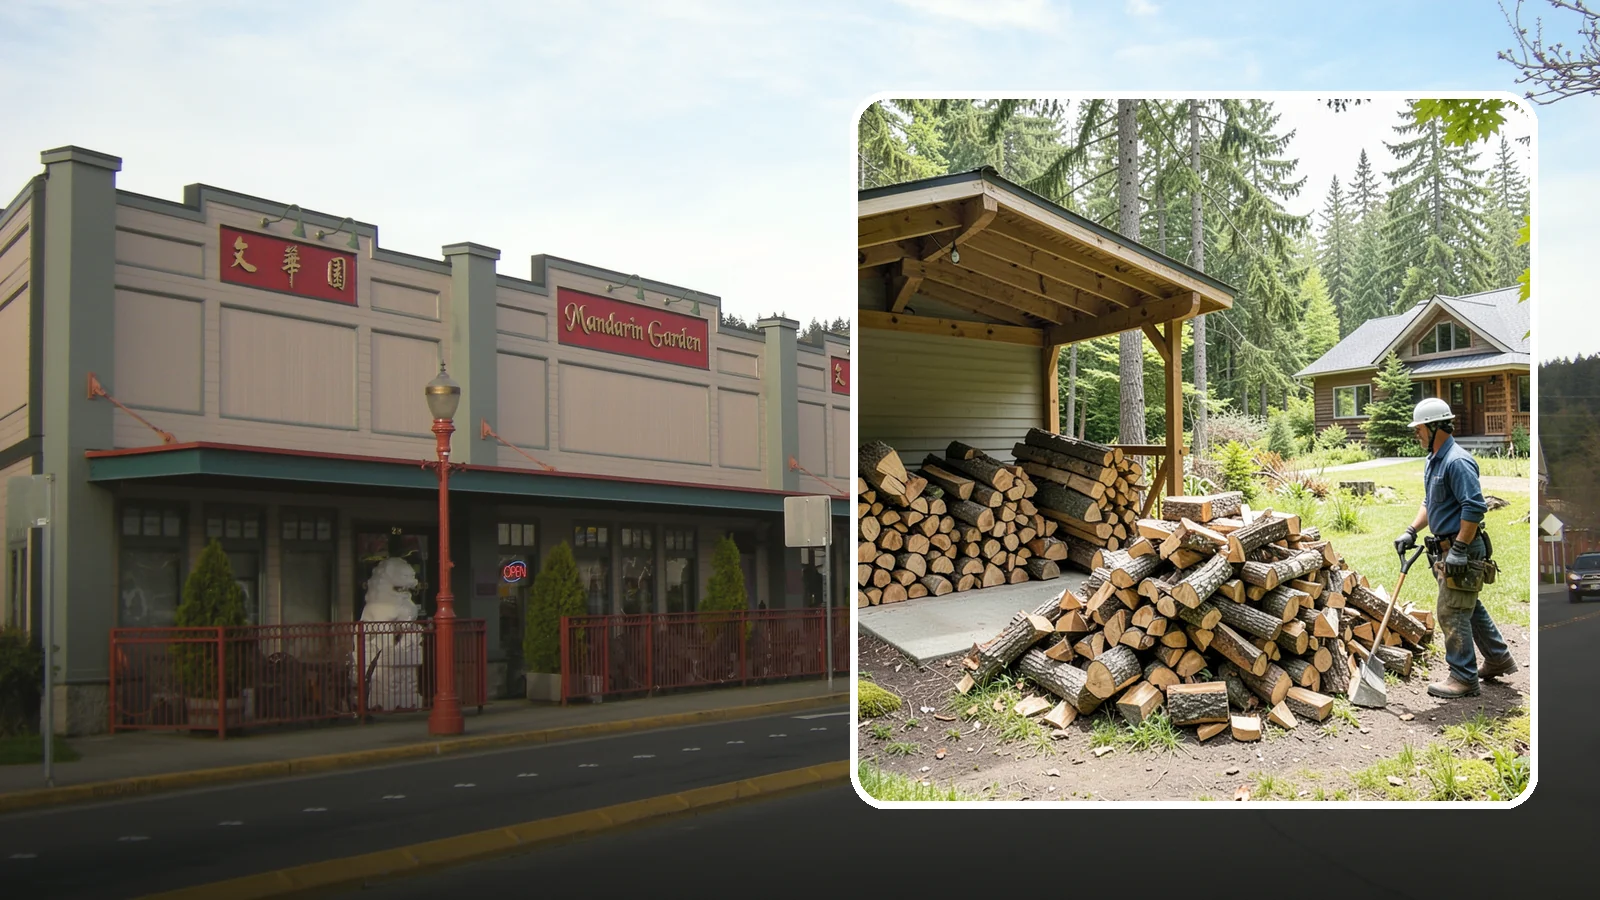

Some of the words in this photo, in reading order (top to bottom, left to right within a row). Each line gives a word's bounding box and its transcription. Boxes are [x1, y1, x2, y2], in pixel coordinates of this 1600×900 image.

[231, 236, 346, 291] 文華園
[565, 302, 644, 340] Mandarin
[648, 320, 701, 352] Garden
[503, 565, 526, 578] OPEN
